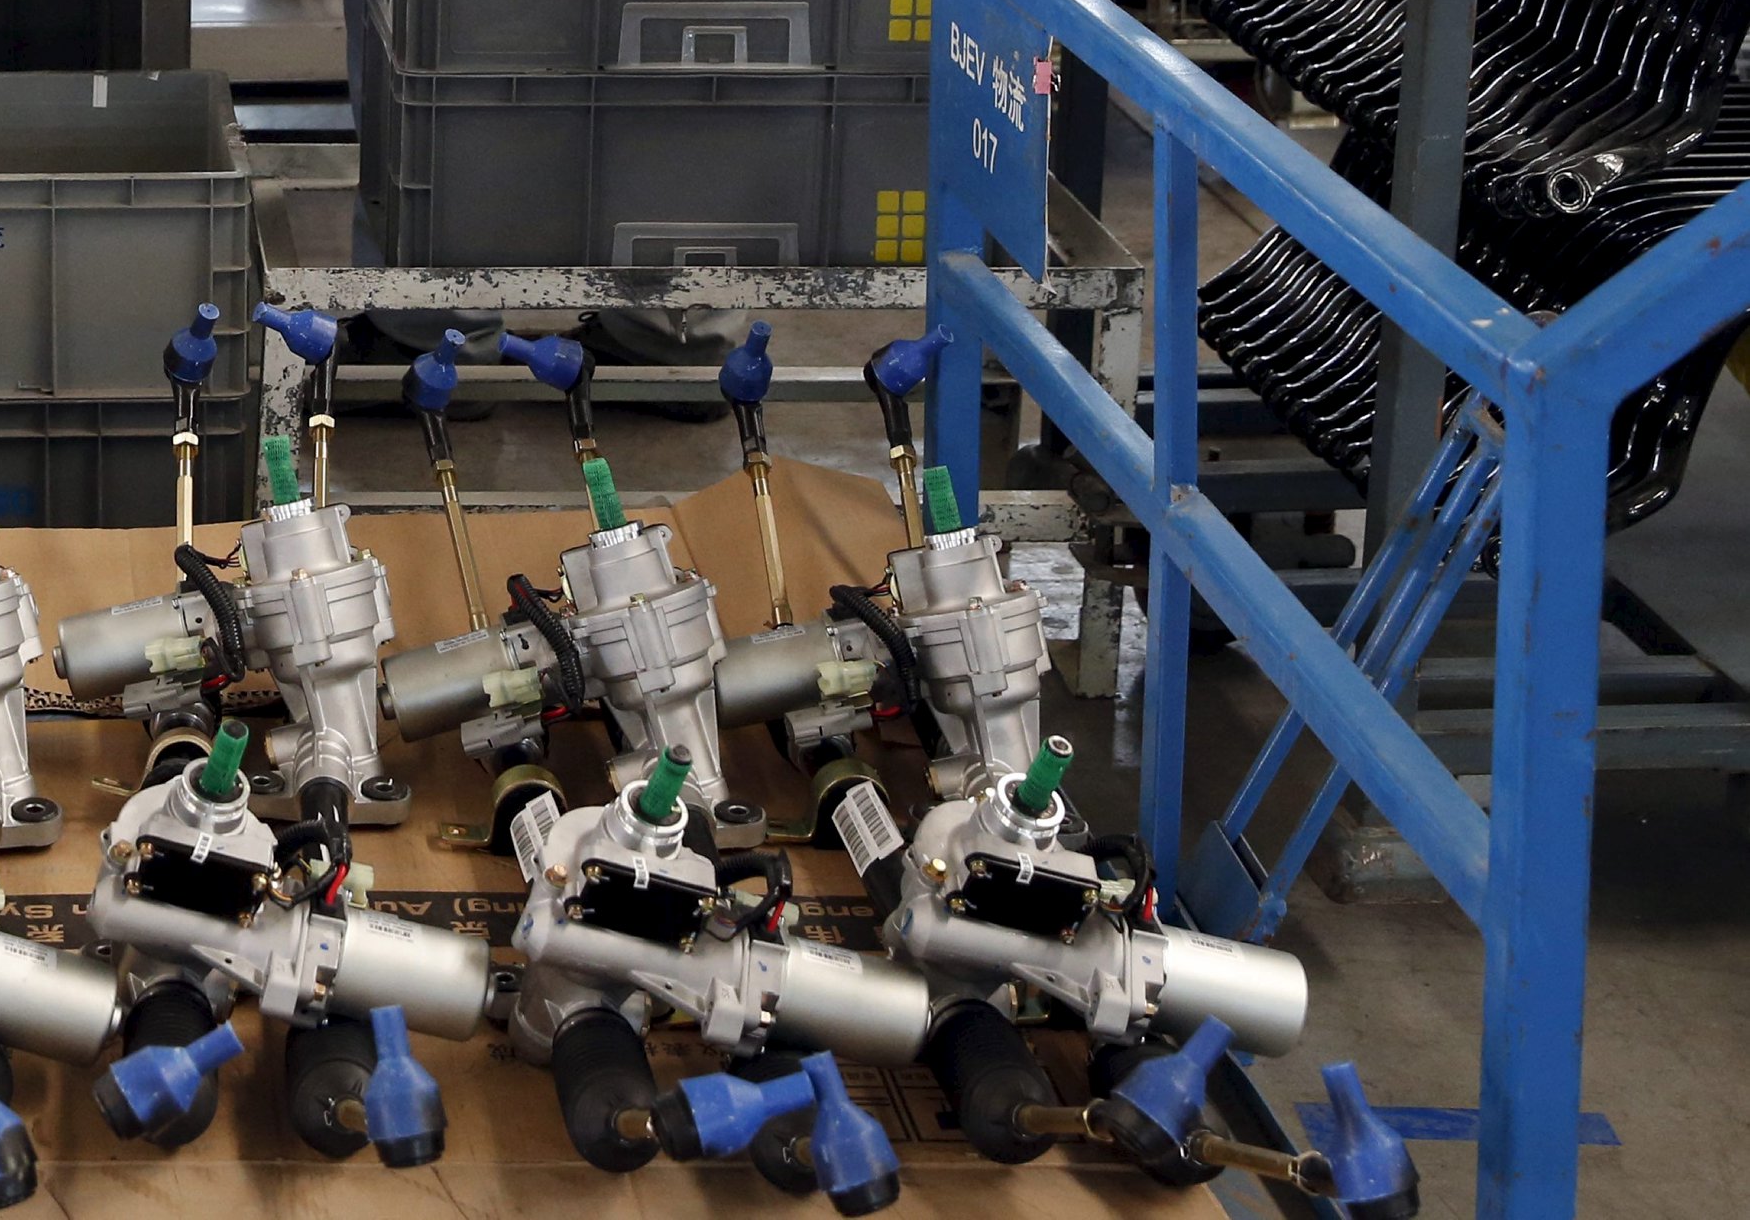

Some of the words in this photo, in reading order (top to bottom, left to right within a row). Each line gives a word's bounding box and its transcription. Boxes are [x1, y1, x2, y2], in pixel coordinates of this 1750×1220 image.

[950, 21, 986, 86] BJEV
[992, 55, 1027, 133] 物流
[972, 117, 998, 174] 017
